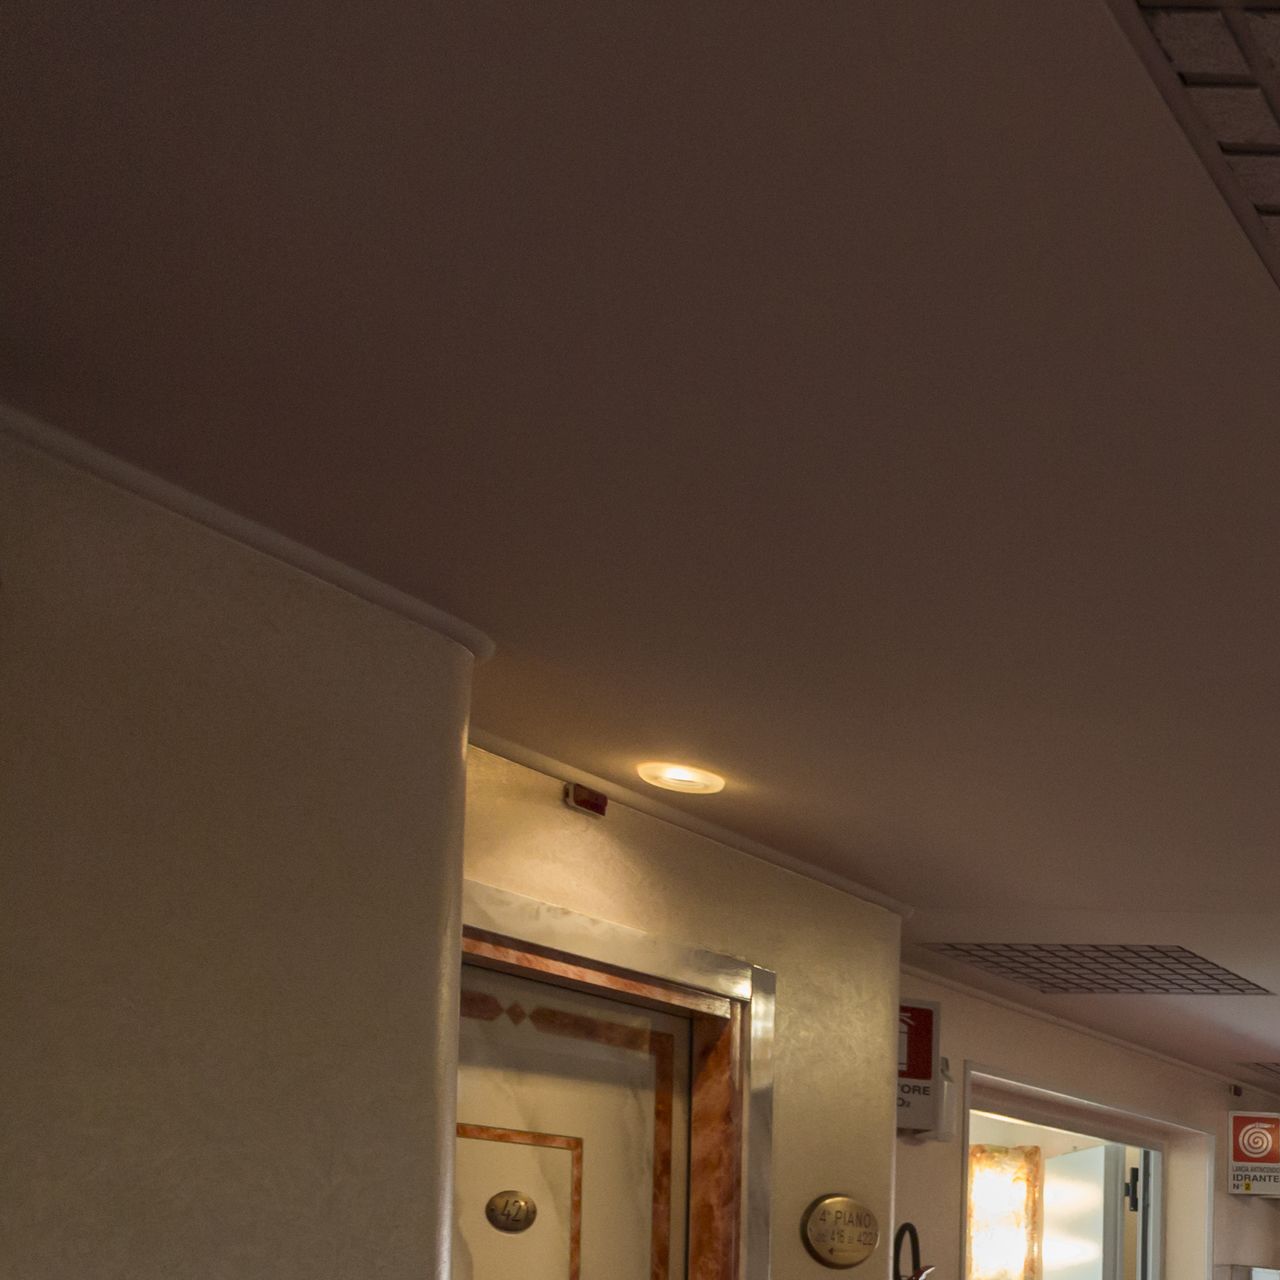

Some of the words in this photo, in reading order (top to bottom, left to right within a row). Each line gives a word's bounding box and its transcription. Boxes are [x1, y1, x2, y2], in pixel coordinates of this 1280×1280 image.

[1232, 1174, 1280, 1183] IDRANTE
[1244, 1183, 1251, 1191] 2
[834, 1210, 872, 1229] PIANO
